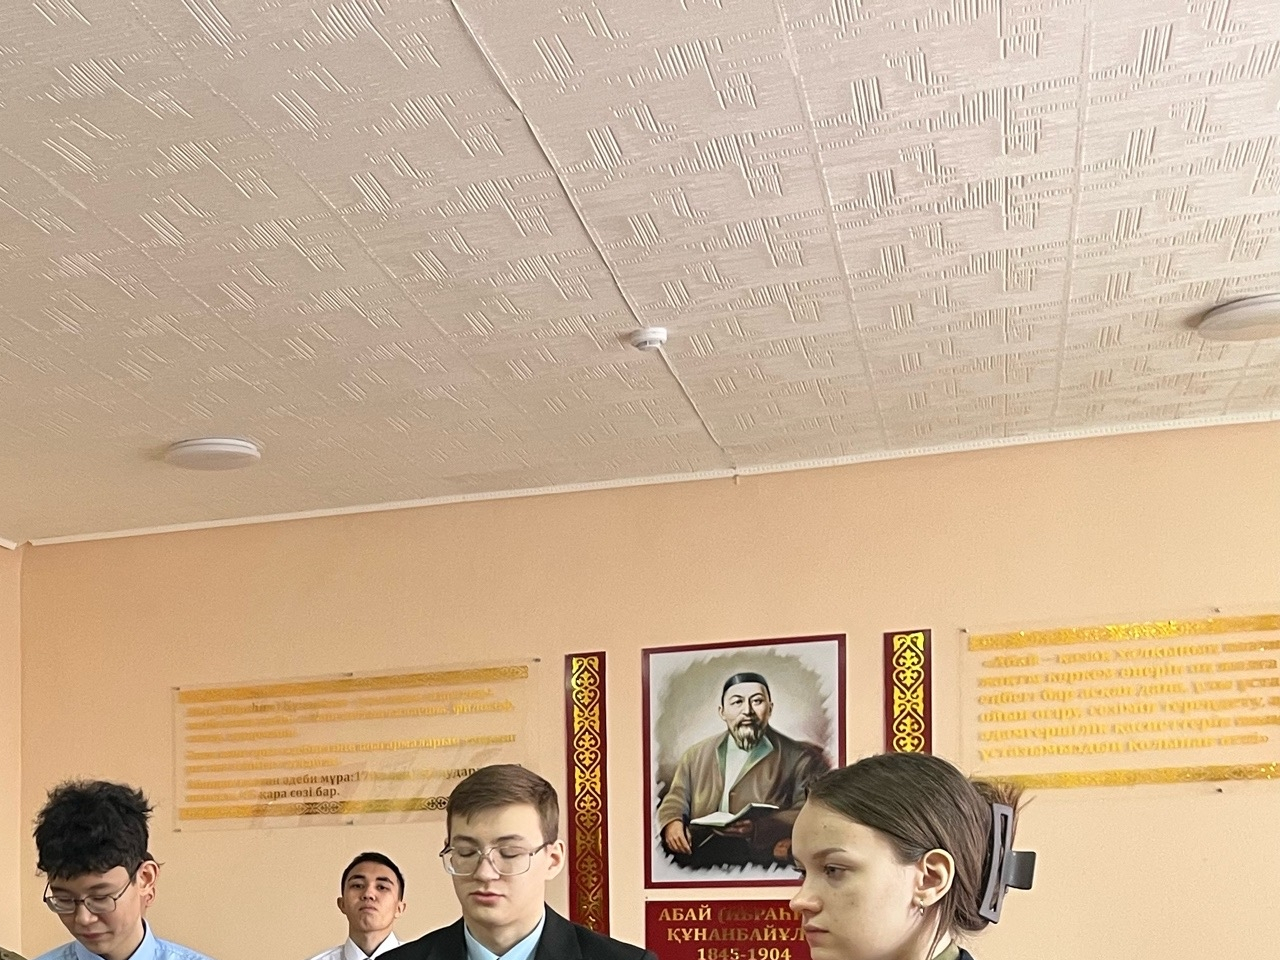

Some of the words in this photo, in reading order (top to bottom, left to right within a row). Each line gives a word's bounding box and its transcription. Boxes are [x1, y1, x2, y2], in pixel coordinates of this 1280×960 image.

[282, 774, 317, 786] әдеби
[259, 790, 287, 801] қара
[290, 787, 313, 798] сөзі
[316, 786, 340, 799] бар.
[658, 904, 712, 921] АБАЙ
[667, 924, 806, 944] ҚҰНАНБАЙҰЛ
